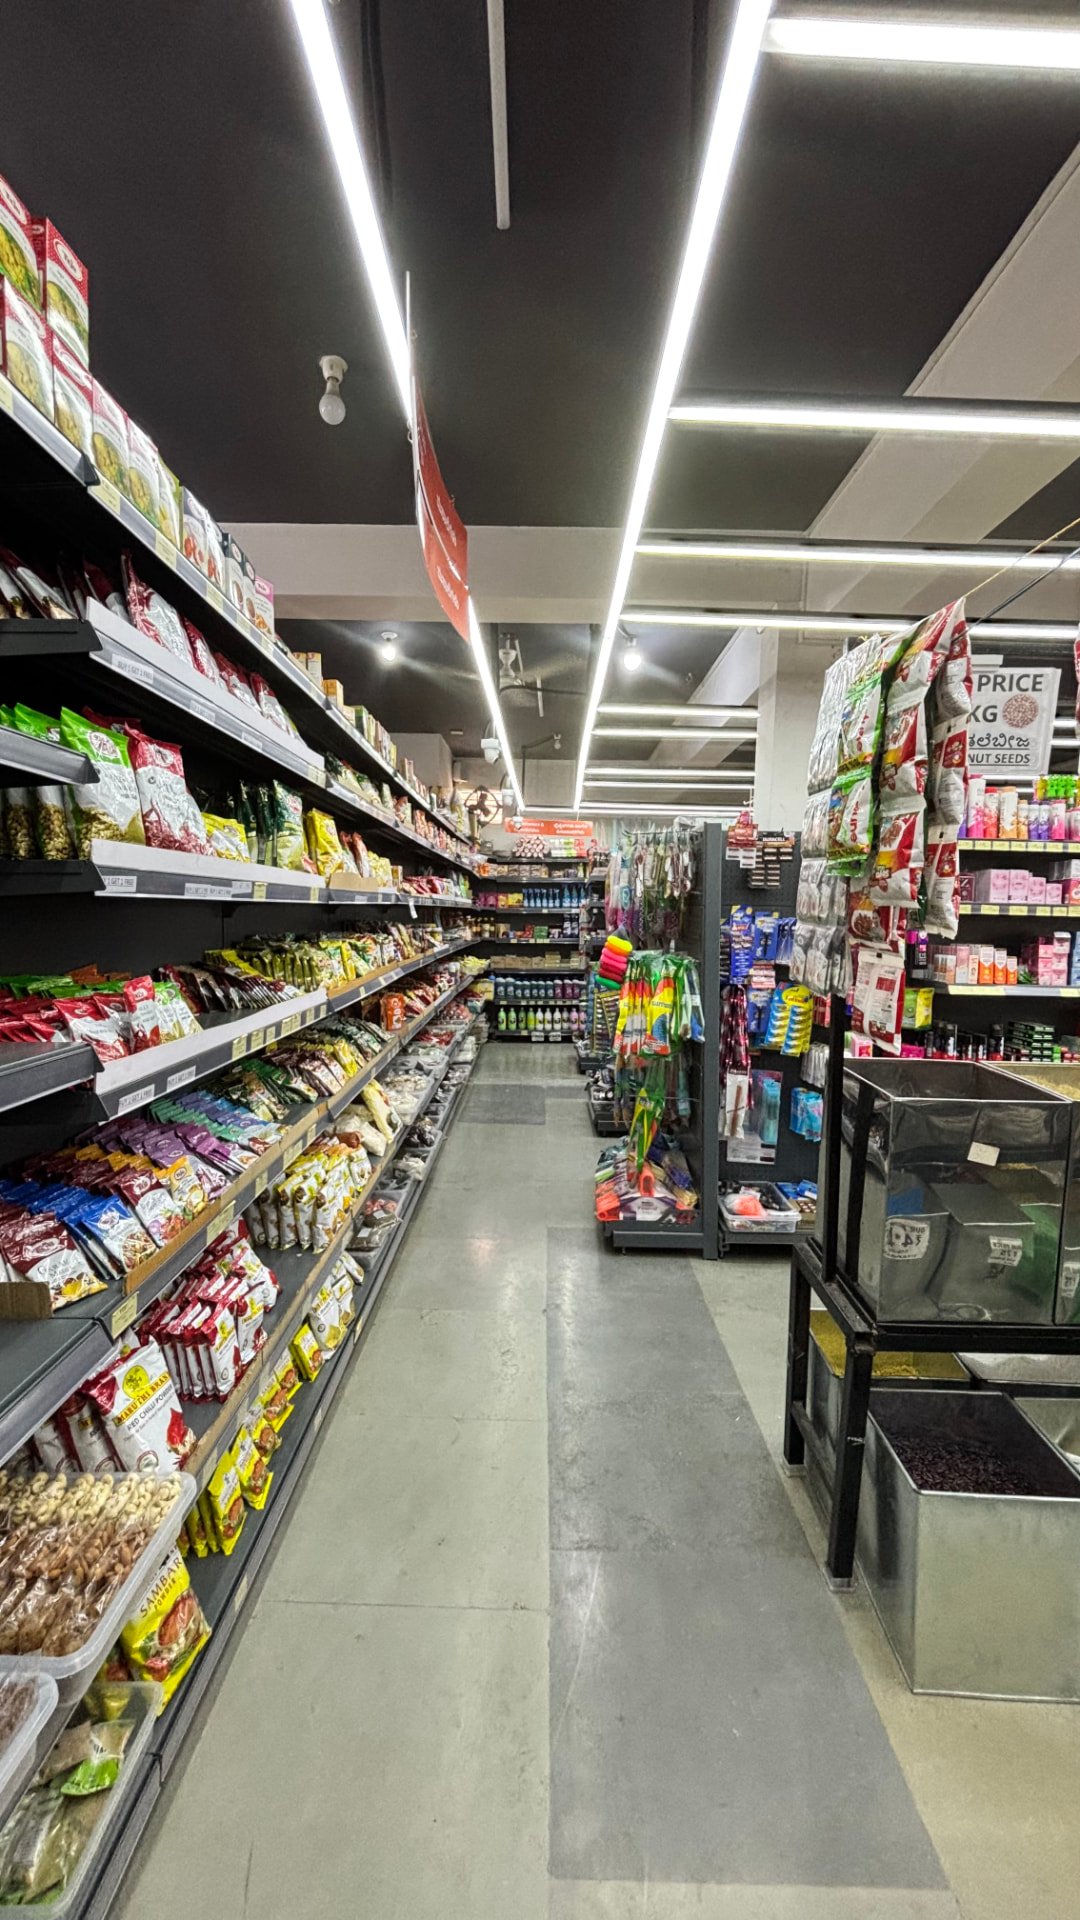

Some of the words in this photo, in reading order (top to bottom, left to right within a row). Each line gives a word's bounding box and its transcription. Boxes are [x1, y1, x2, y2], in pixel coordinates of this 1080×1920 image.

[977, 674, 1044, 692] PRICE
[969, 704, 998, 723] KG
[994, 753, 1030, 764] SEEDS
[116, 1391, 151, 1424] MARUTHI
[150, 1374, 169, 1393] BRAN
[127, 1417, 140, 1431] RED
[139, 1401, 156, 1419] CHILLI
[140, 1556, 182, 1618] SAMBAR
